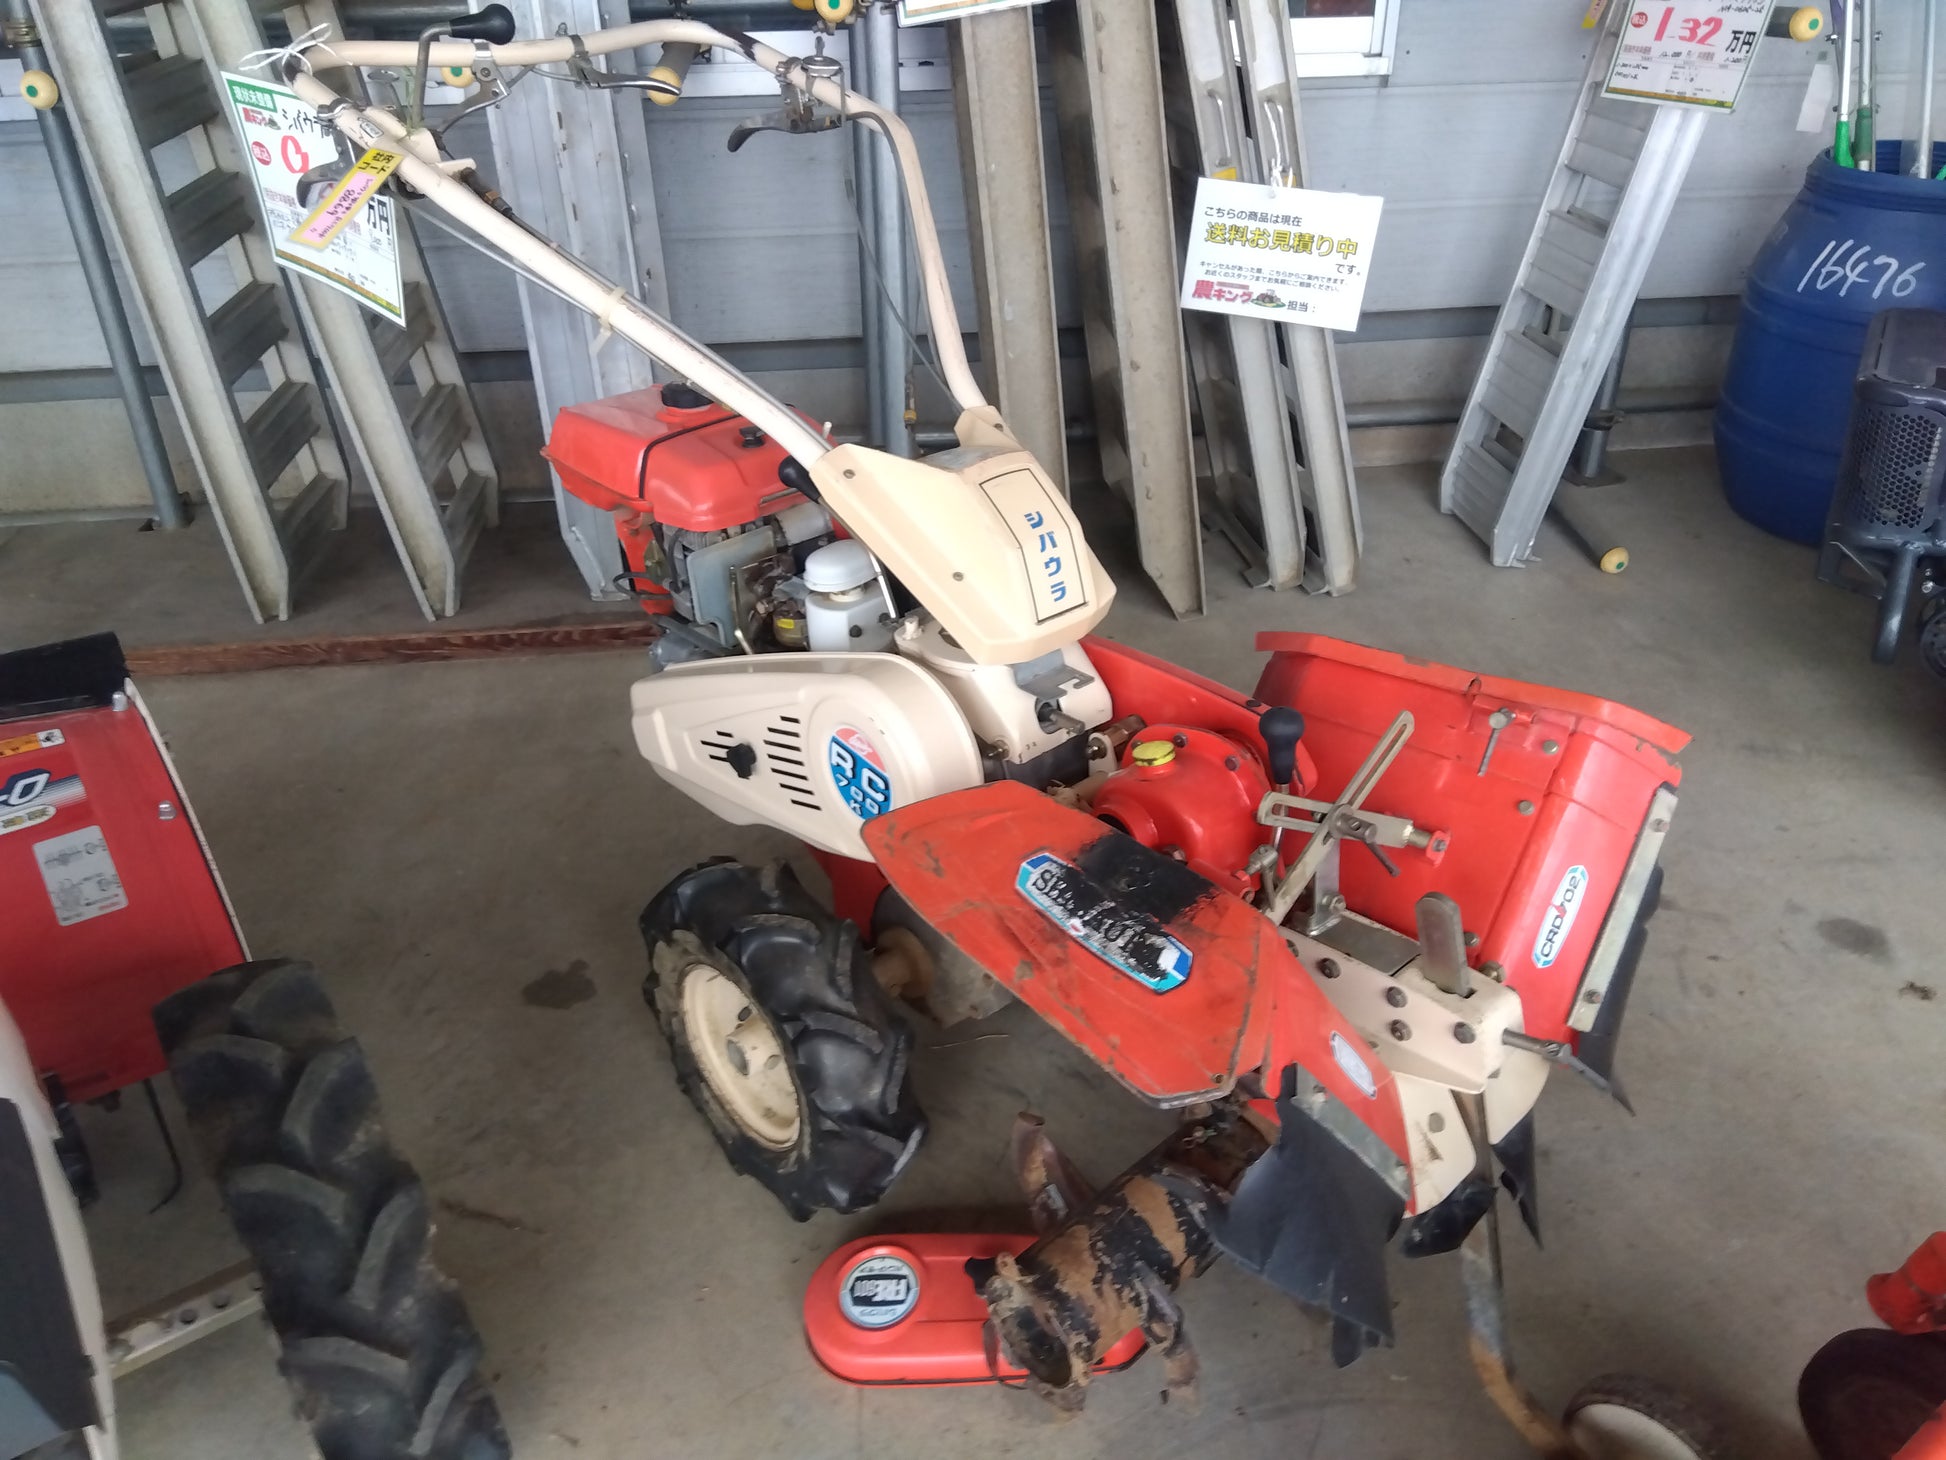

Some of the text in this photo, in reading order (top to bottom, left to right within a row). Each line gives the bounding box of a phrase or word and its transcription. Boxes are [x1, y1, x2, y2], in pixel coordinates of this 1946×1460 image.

[1725, 30, 1757, 54] 万円
[1204, 206, 1303, 227] こちらの商品は現在
[1204, 221, 1359, 260] 送料お見積り中
[1335, 263, 1361, 276] です。
[1797, 239, 1927, 299] 16476
[1024, 511, 1067, 602] シバウラ
[831, 741, 886, 802] RC
